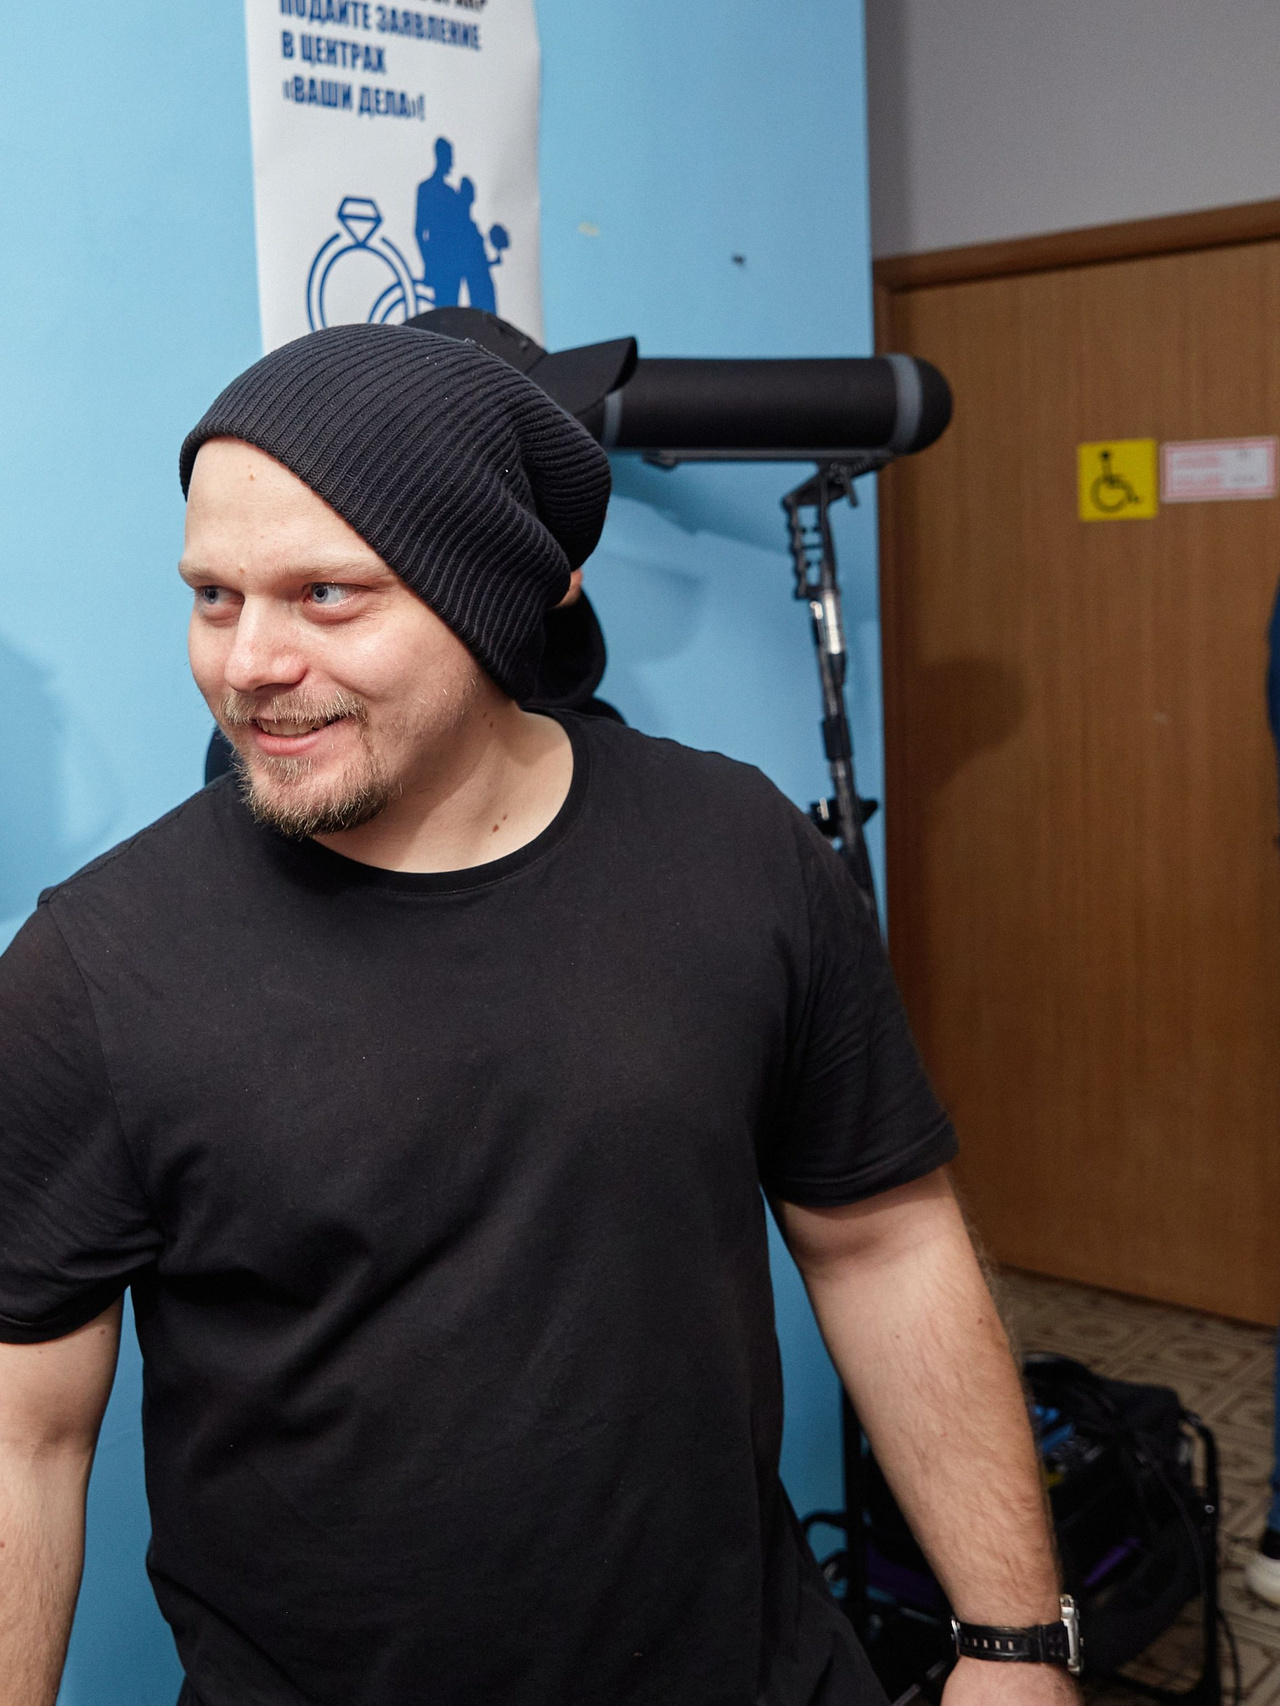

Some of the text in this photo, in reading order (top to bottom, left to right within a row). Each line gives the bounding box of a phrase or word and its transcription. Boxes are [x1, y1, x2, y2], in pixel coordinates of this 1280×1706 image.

[376, 5, 481, 51] ЗАЯВЛЕНИЕ
[282, 31, 386, 73] В ЦЕНТРАХ
